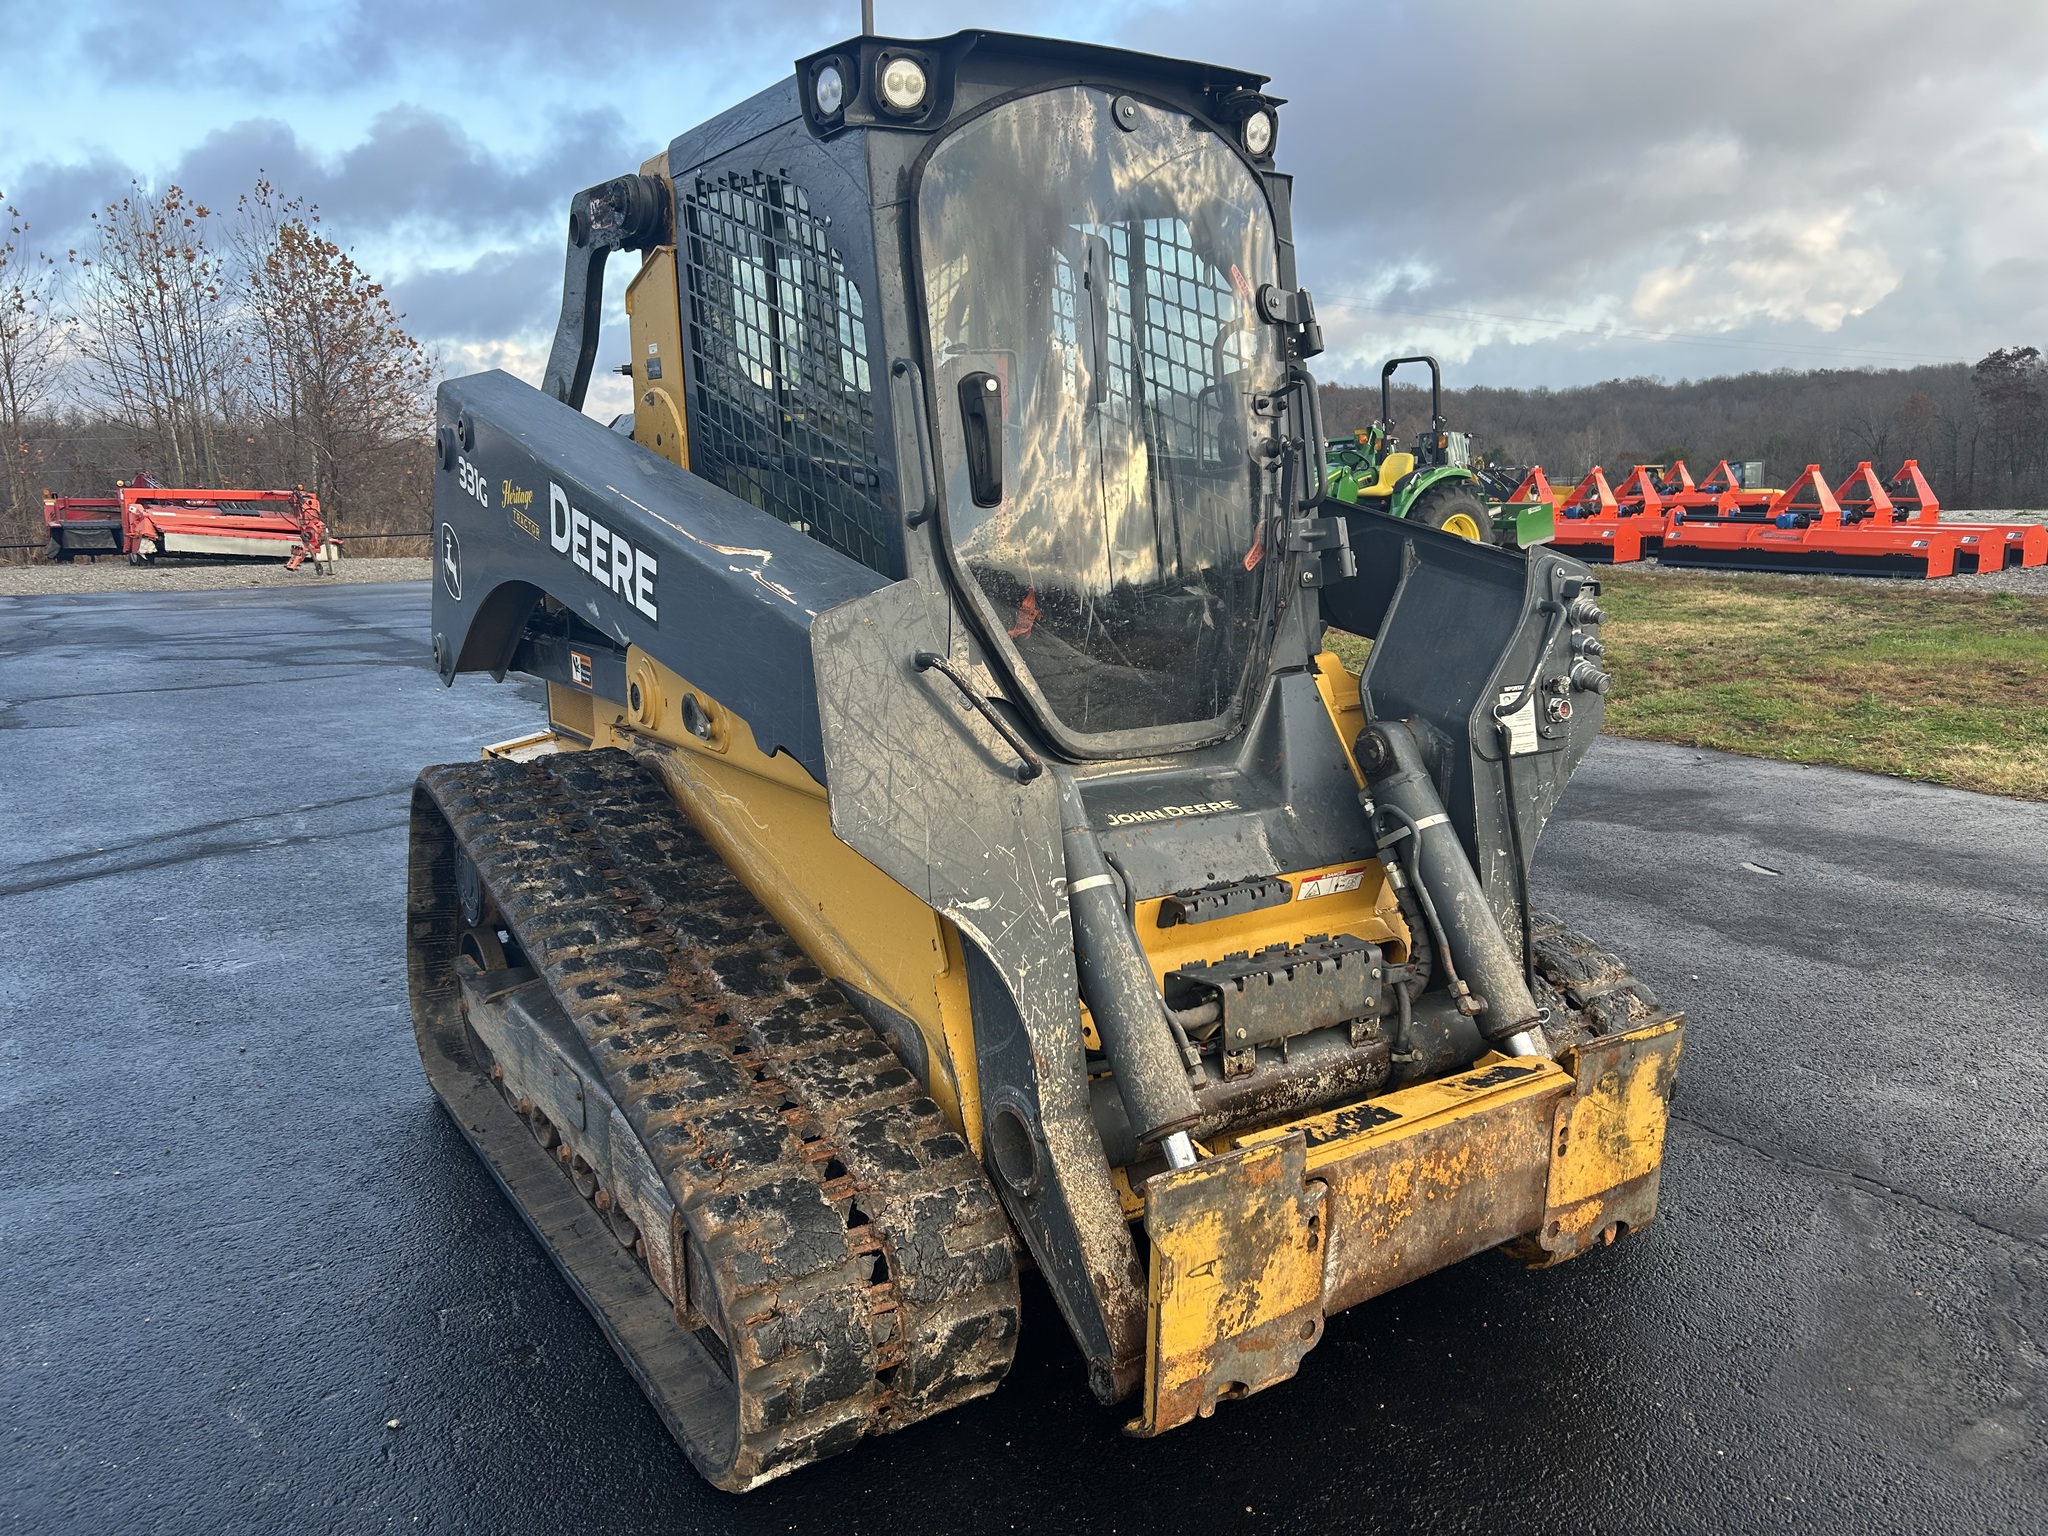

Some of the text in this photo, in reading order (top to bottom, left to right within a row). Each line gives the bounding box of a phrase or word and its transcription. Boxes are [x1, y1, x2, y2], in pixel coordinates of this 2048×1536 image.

[458, 455, 488, 508] 331G
[502, 479, 533, 510] Heritage
[513, 509, 540, 539] TRACTOR
[549, 481, 657, 622] DEERE
[1107, 800, 1239, 826] JOHN DEERE
